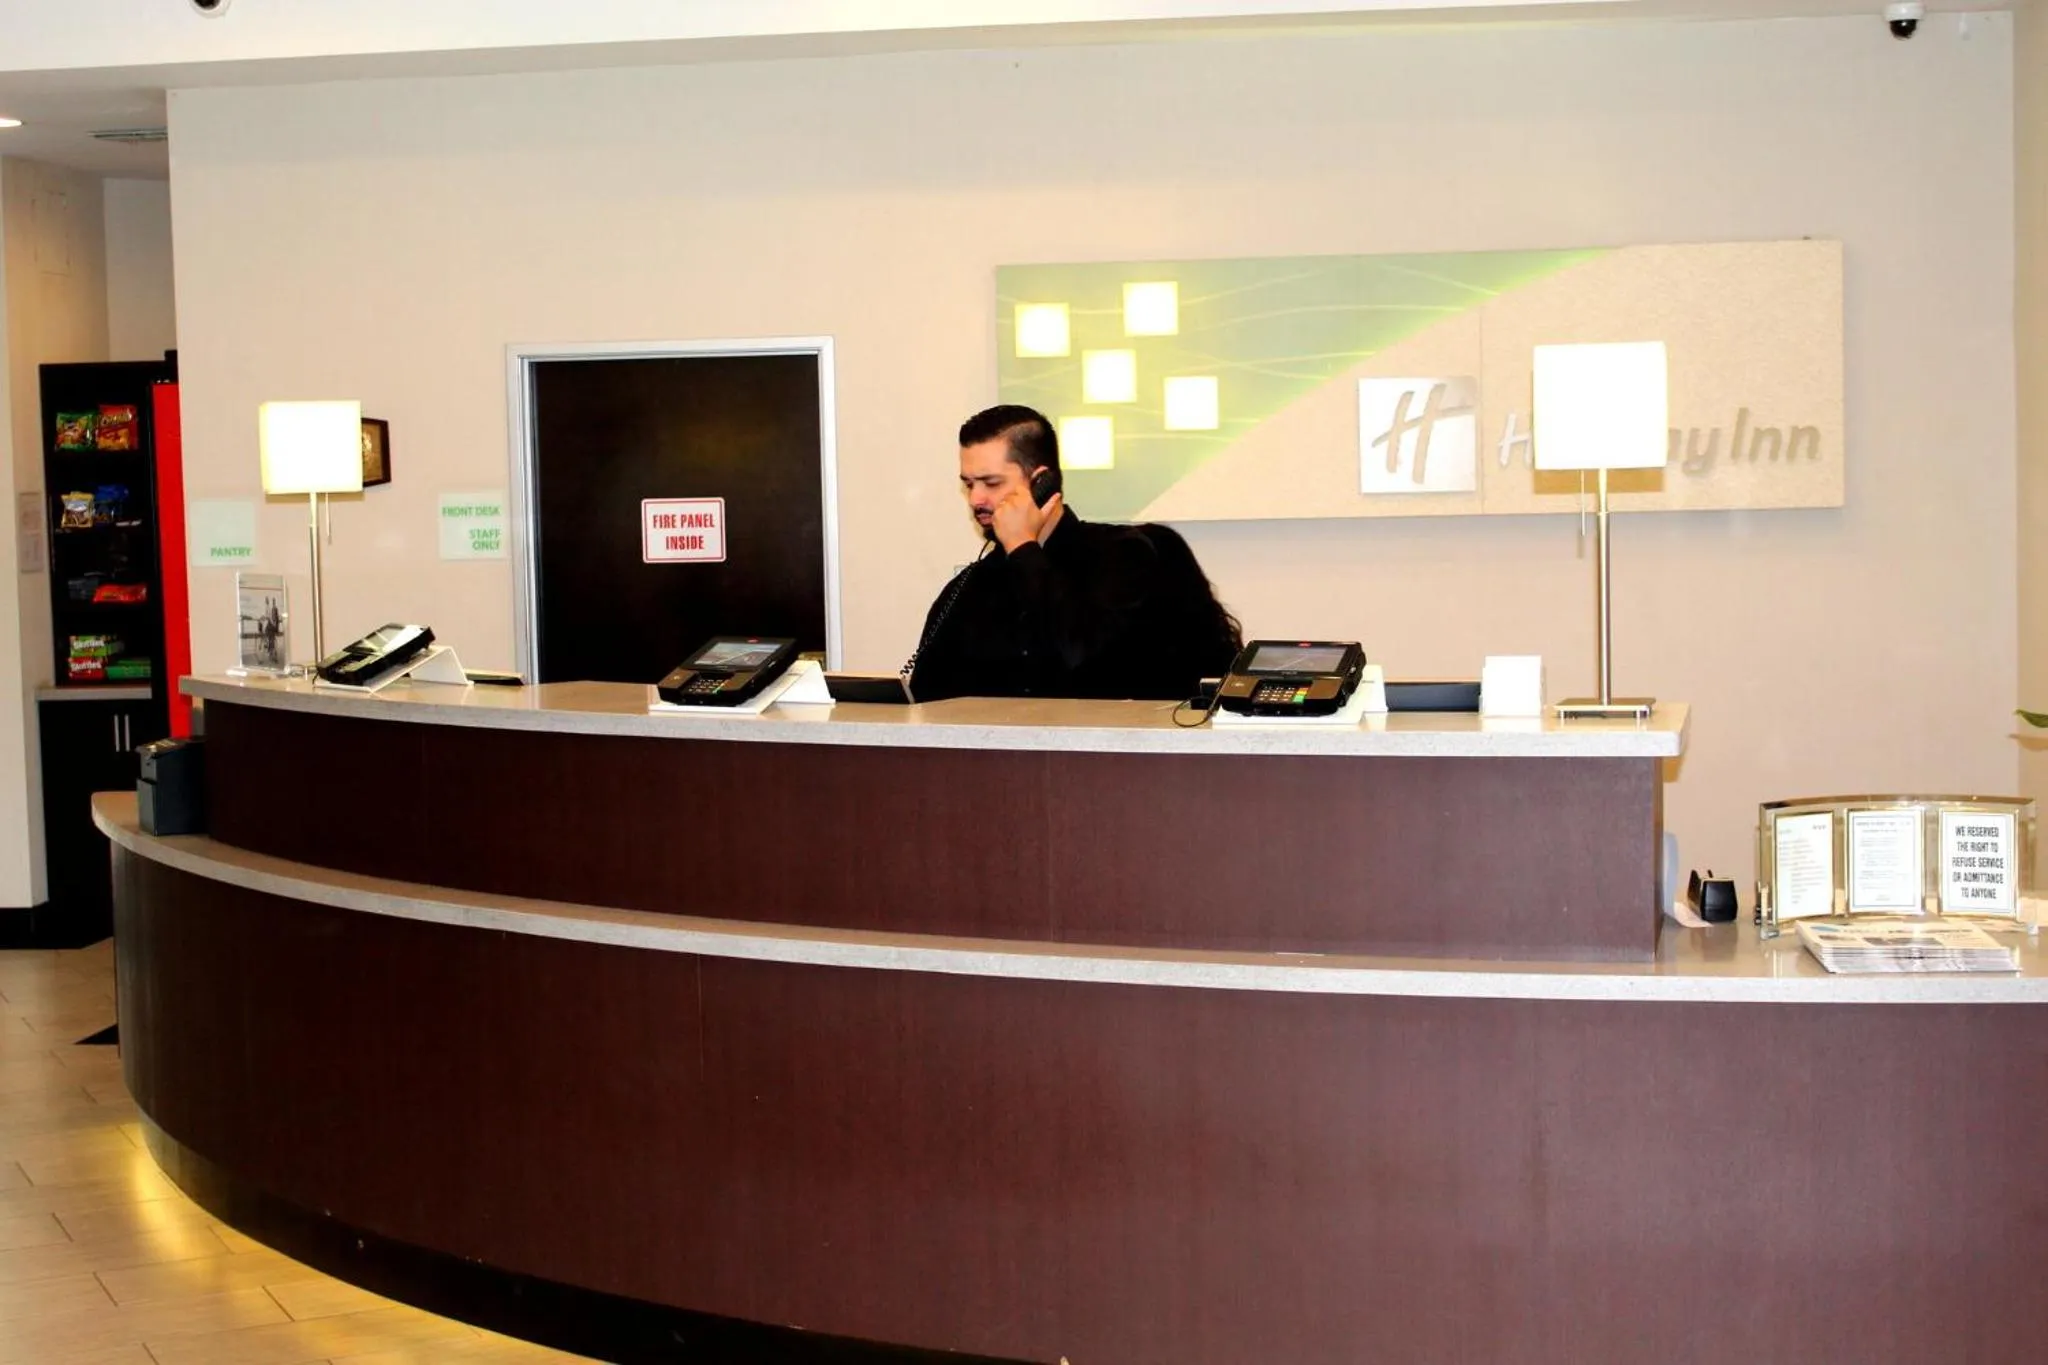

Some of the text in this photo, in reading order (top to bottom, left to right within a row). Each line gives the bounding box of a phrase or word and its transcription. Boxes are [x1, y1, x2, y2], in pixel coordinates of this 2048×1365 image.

[1730, 407, 1822, 463] Inn
[442, 505, 501, 517] FRONT DESK
[653, 513, 715, 528] FIRE PANEL
[469, 528, 501, 540] STAFF
[472, 540, 500, 551] ONLY
[665, 535, 704, 550] INSIDE
[211, 547, 252, 558] PANTRY
[1955, 826, 1999, 838] WE RESERVED
[1957, 842, 1999, 853] THE RIGHT TO
[1952, 857, 2004, 869] REFUSE SERVICE
[1953, 872, 2004, 884] OR ADMITTANCE
[1961, 887, 1997, 899] TO ANYONE
